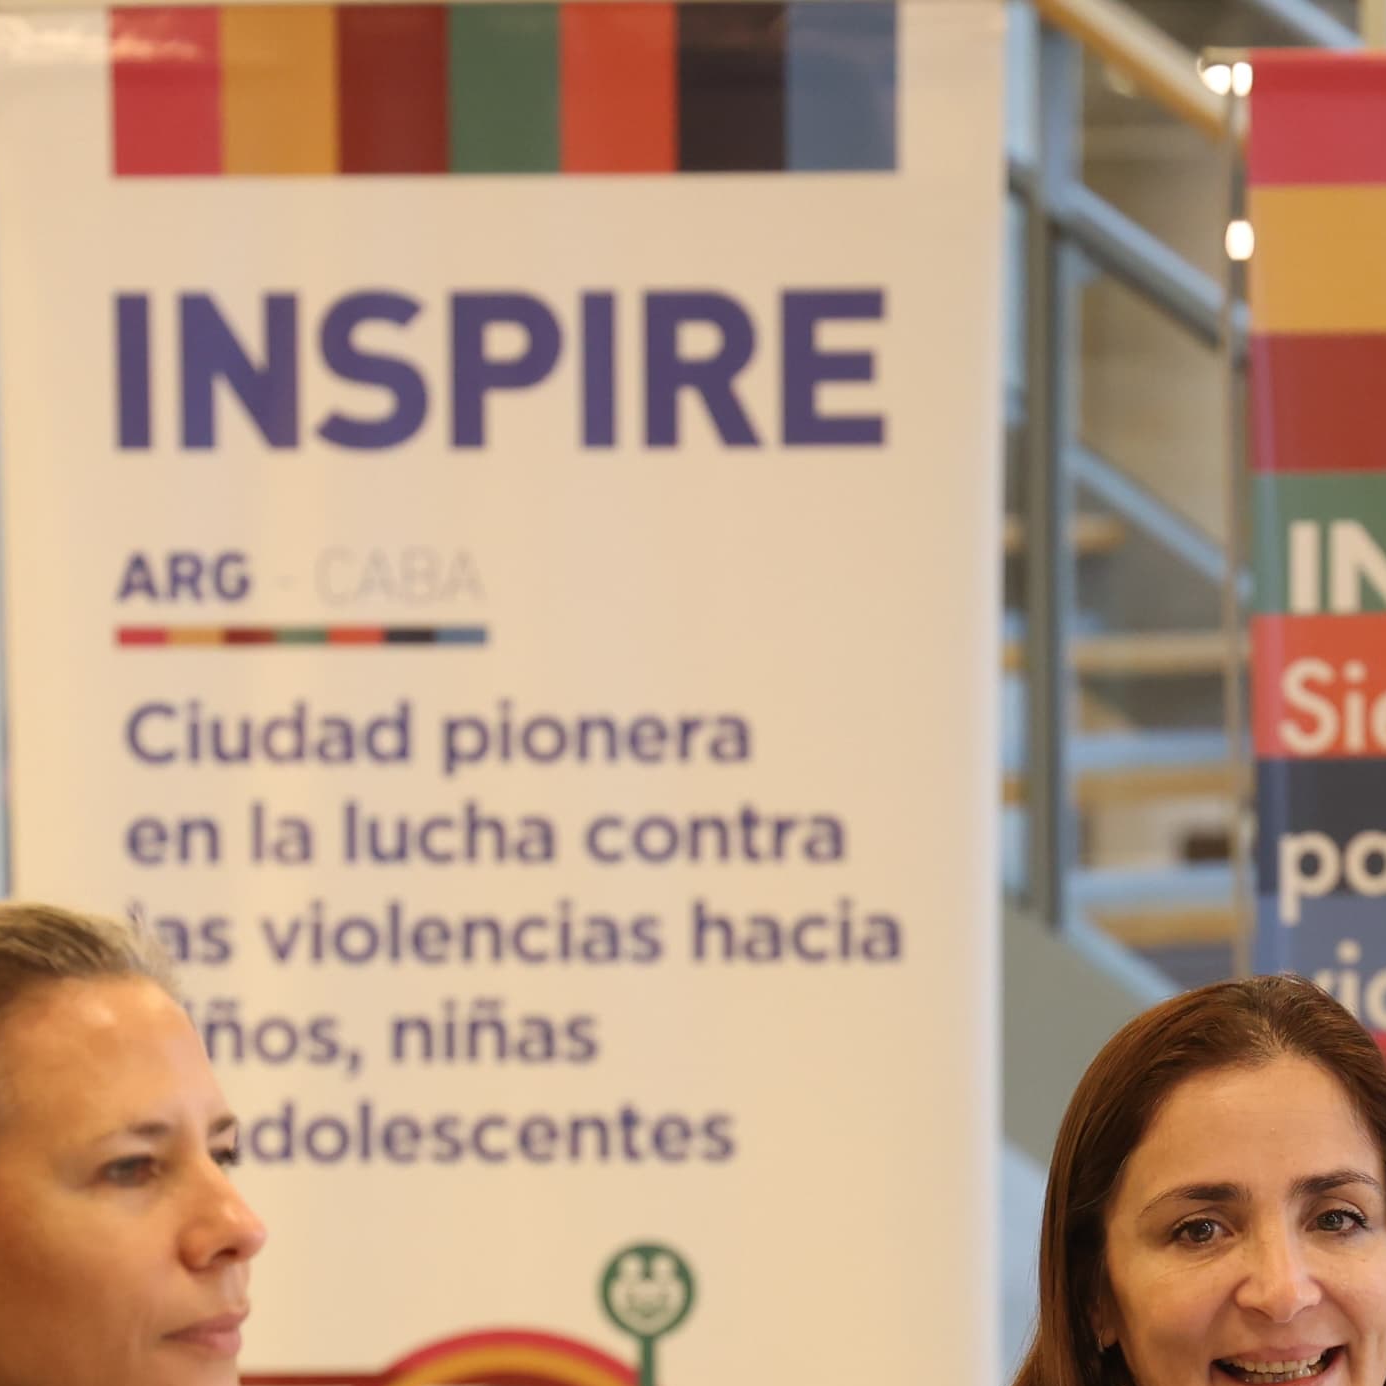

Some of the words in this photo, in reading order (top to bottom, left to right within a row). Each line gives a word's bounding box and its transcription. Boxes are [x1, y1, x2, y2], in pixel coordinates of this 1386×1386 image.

[112, 287, 886, 450] INSPIRE
[116, 552, 251, 602] ARG
[317, 550, 485, 604] CABA
[125, 700, 411, 765] Ciudad
[443, 700, 751, 775] pionera
[126, 814, 220, 863] en
[251, 803, 314, 863] la
[344, 800, 556, 863] lucha
[586, 806, 846, 863] contra
[261, 898, 663, 963] violencias
[691, 898, 903, 963] hacia
[181, 998, 365, 1075] ños,
[390, 998, 598, 1063] niñas
[233, 1100, 735, 1164] dolescentes
